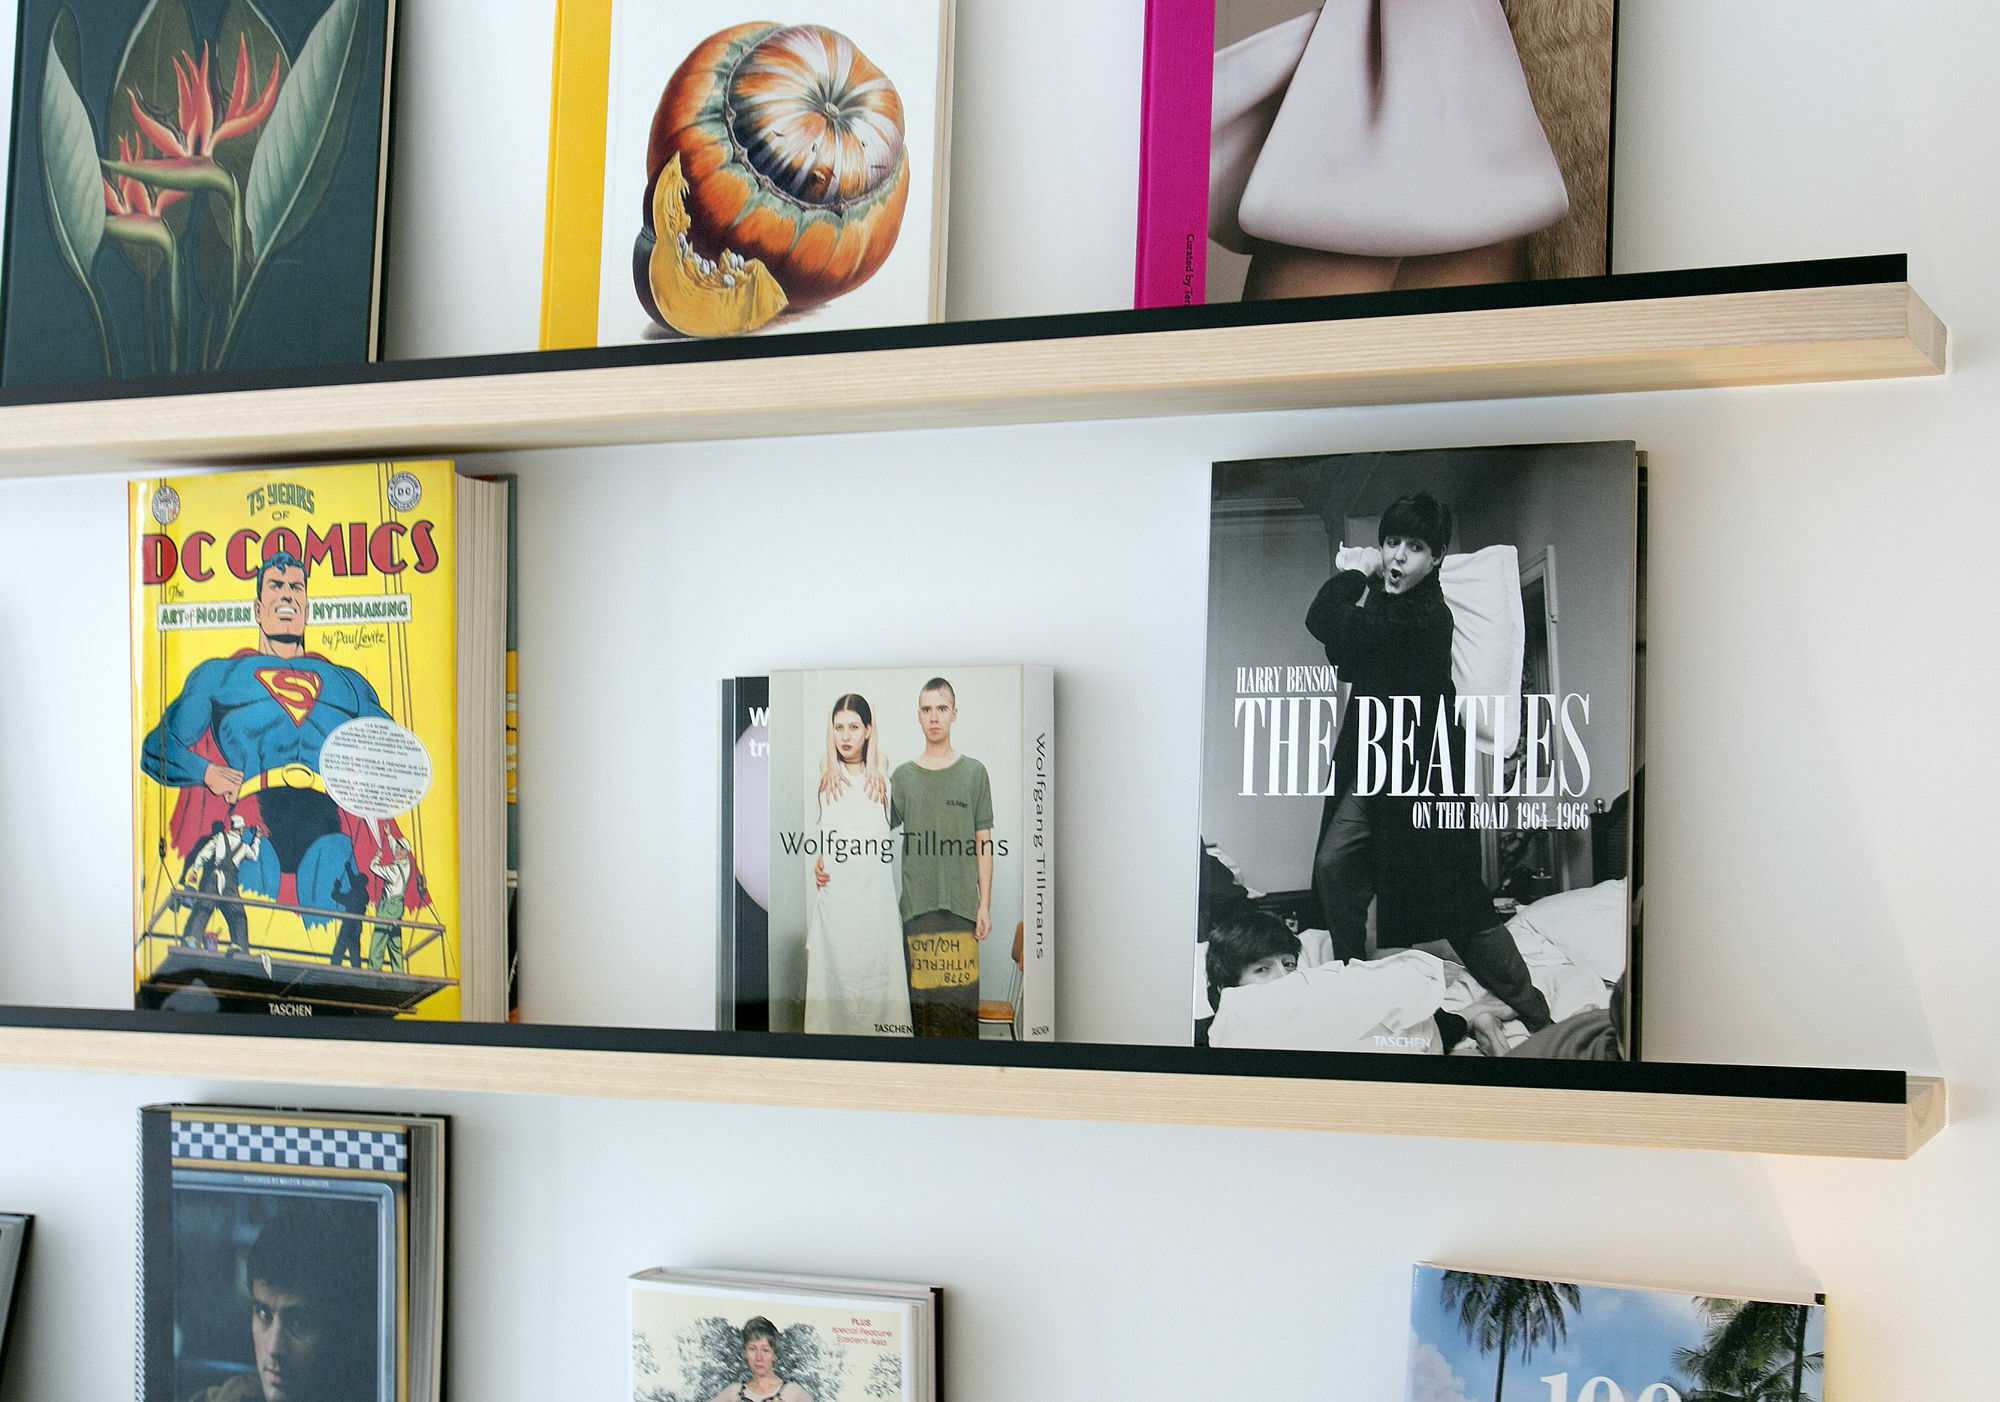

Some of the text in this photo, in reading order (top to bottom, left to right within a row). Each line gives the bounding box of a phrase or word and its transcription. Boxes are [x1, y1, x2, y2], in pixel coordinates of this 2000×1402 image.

[1185, 233, 1195, 272] Curated
[1183, 274, 1194, 286] by
[247, 483, 315, 516] 75 YEARS
[398, 487, 411, 495] DC
[271, 510, 290, 521] OF
[142, 519, 439, 585] DC COMICS
[168, 582, 184, 602] The
[161, 608, 185, 625] ART
[196, 606, 251, 624] MODERN
[313, 600, 408, 620] MYTHMAKING
[322, 624, 385, 650] by Paul Levitz
[1236, 665, 1339, 693] HARRY BENSON
[1234, 693, 1591, 798] THE BEATLES
[1412, 801, 1433, 829] ON
[1436, 801, 1466, 829] THE
[1469, 801, 1509, 829] ROAD
[780, 830, 1009, 863] Wolfgang Tillmans
[1033, 732, 1047, 960] Wolfgang Tillmans
[268, 1002, 313, 1018] TASCHEN
[873, 1023, 914, 1034] TASCHEN
[1373, 1035, 1431, 1049] TASCHEN
[851, 1318, 872, 1326] PLUS
